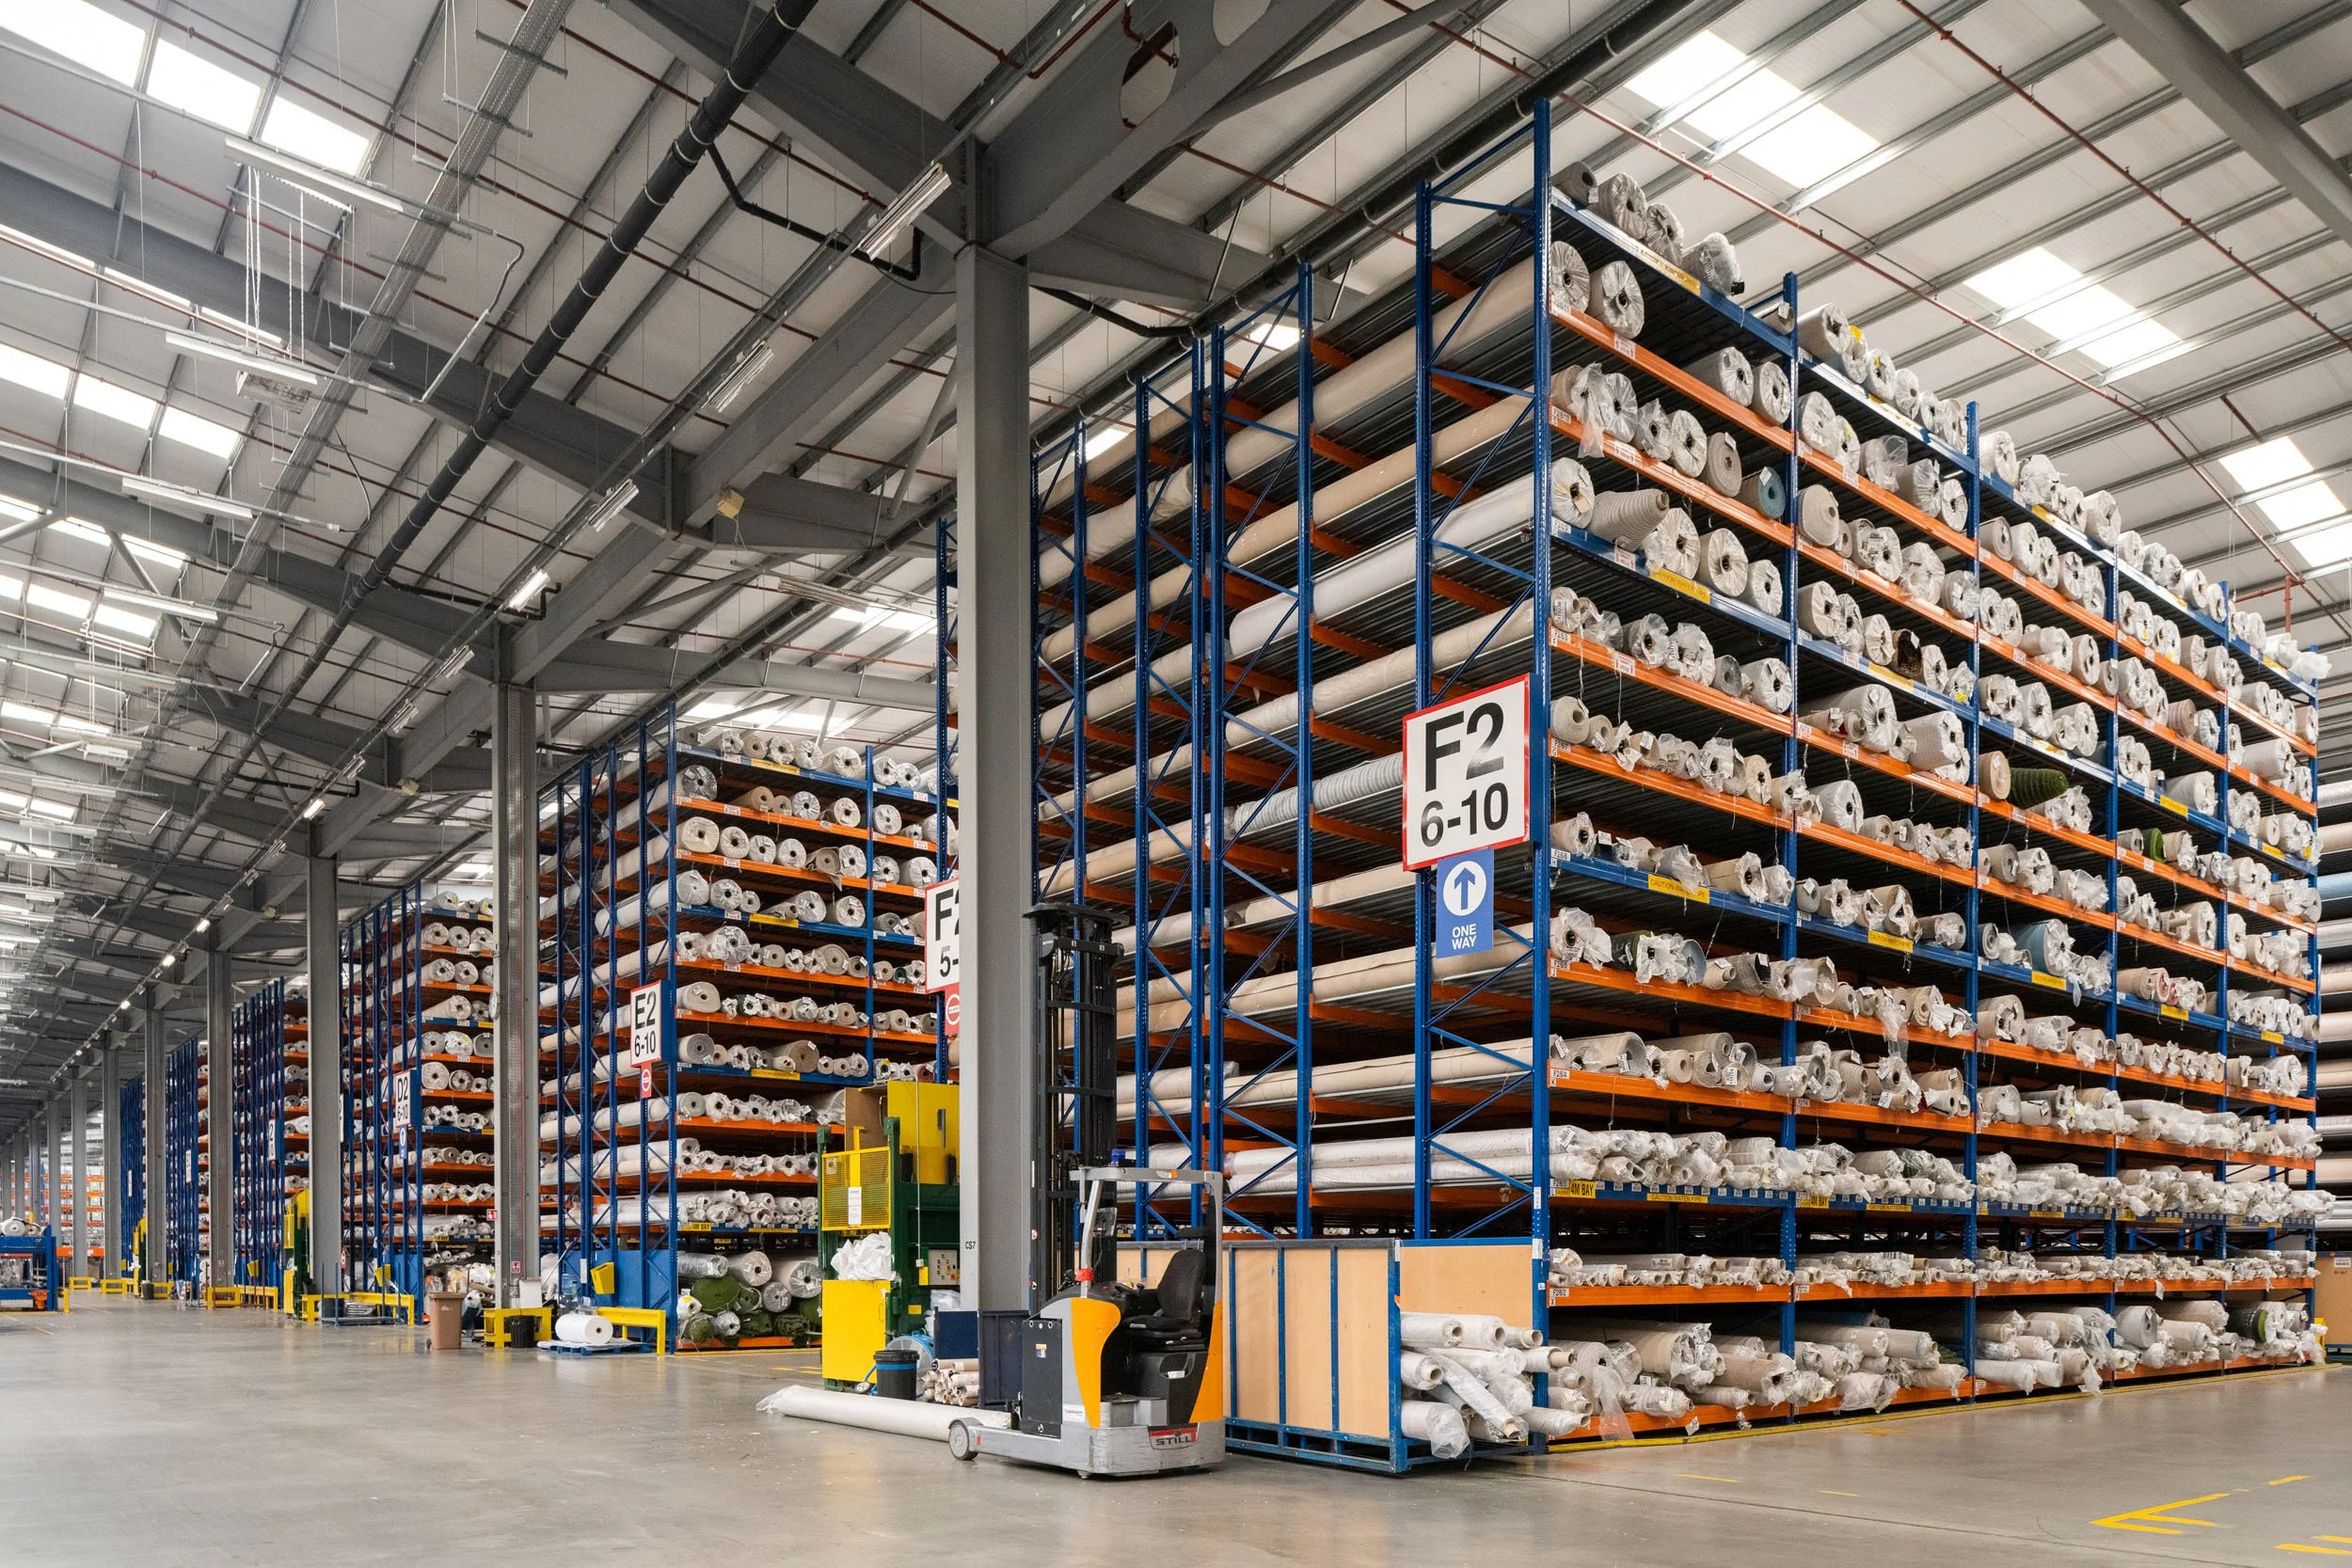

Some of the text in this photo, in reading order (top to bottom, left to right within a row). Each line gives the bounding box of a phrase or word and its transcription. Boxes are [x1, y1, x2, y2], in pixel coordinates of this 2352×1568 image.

[1424, 702, 1504, 792] F2
[1420, 782, 1509, 847] 6-10
[1650, 879, 1674, 891] CAUTION
[935, 888, 959, 942] F
[1452, 924, 1476, 939] ONE
[1452, 936, 1477, 950] WAY
[635, 990, 657, 1030] E2
[634, 1030, 657, 1058] 6-10
[397, 1076, 408, 1102] D2
[397, 1103, 408, 1123] 6-10
[1570, 1182, 1581, 1196] 4M
[1581, 1183, 1595, 1197] BAY
[1819, 1196, 1828, 1207] BAY
[1155, 1435, 1191, 1447] STILL
